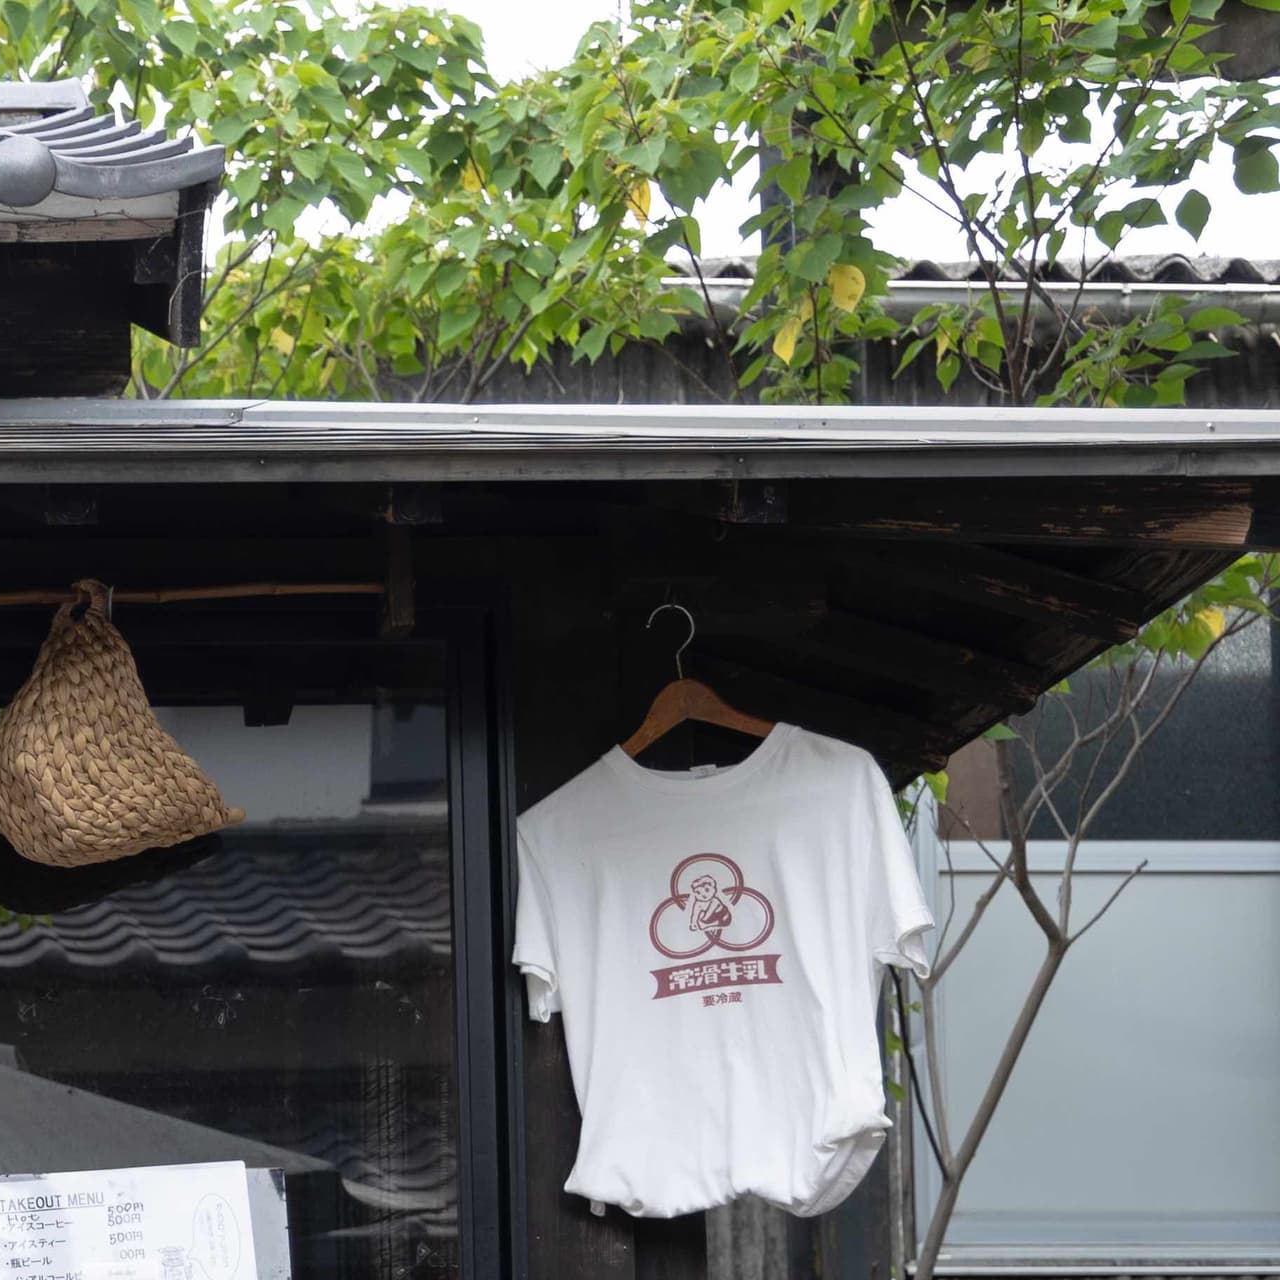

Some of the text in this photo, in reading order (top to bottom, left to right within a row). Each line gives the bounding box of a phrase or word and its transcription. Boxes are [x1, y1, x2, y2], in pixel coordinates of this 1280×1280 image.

[669, 959, 768, 991] 常滑牛乳
[702, 991, 743, 1007] 要冷蔵
[0, 1191, 105, 1212] TAKEOUT MENU
